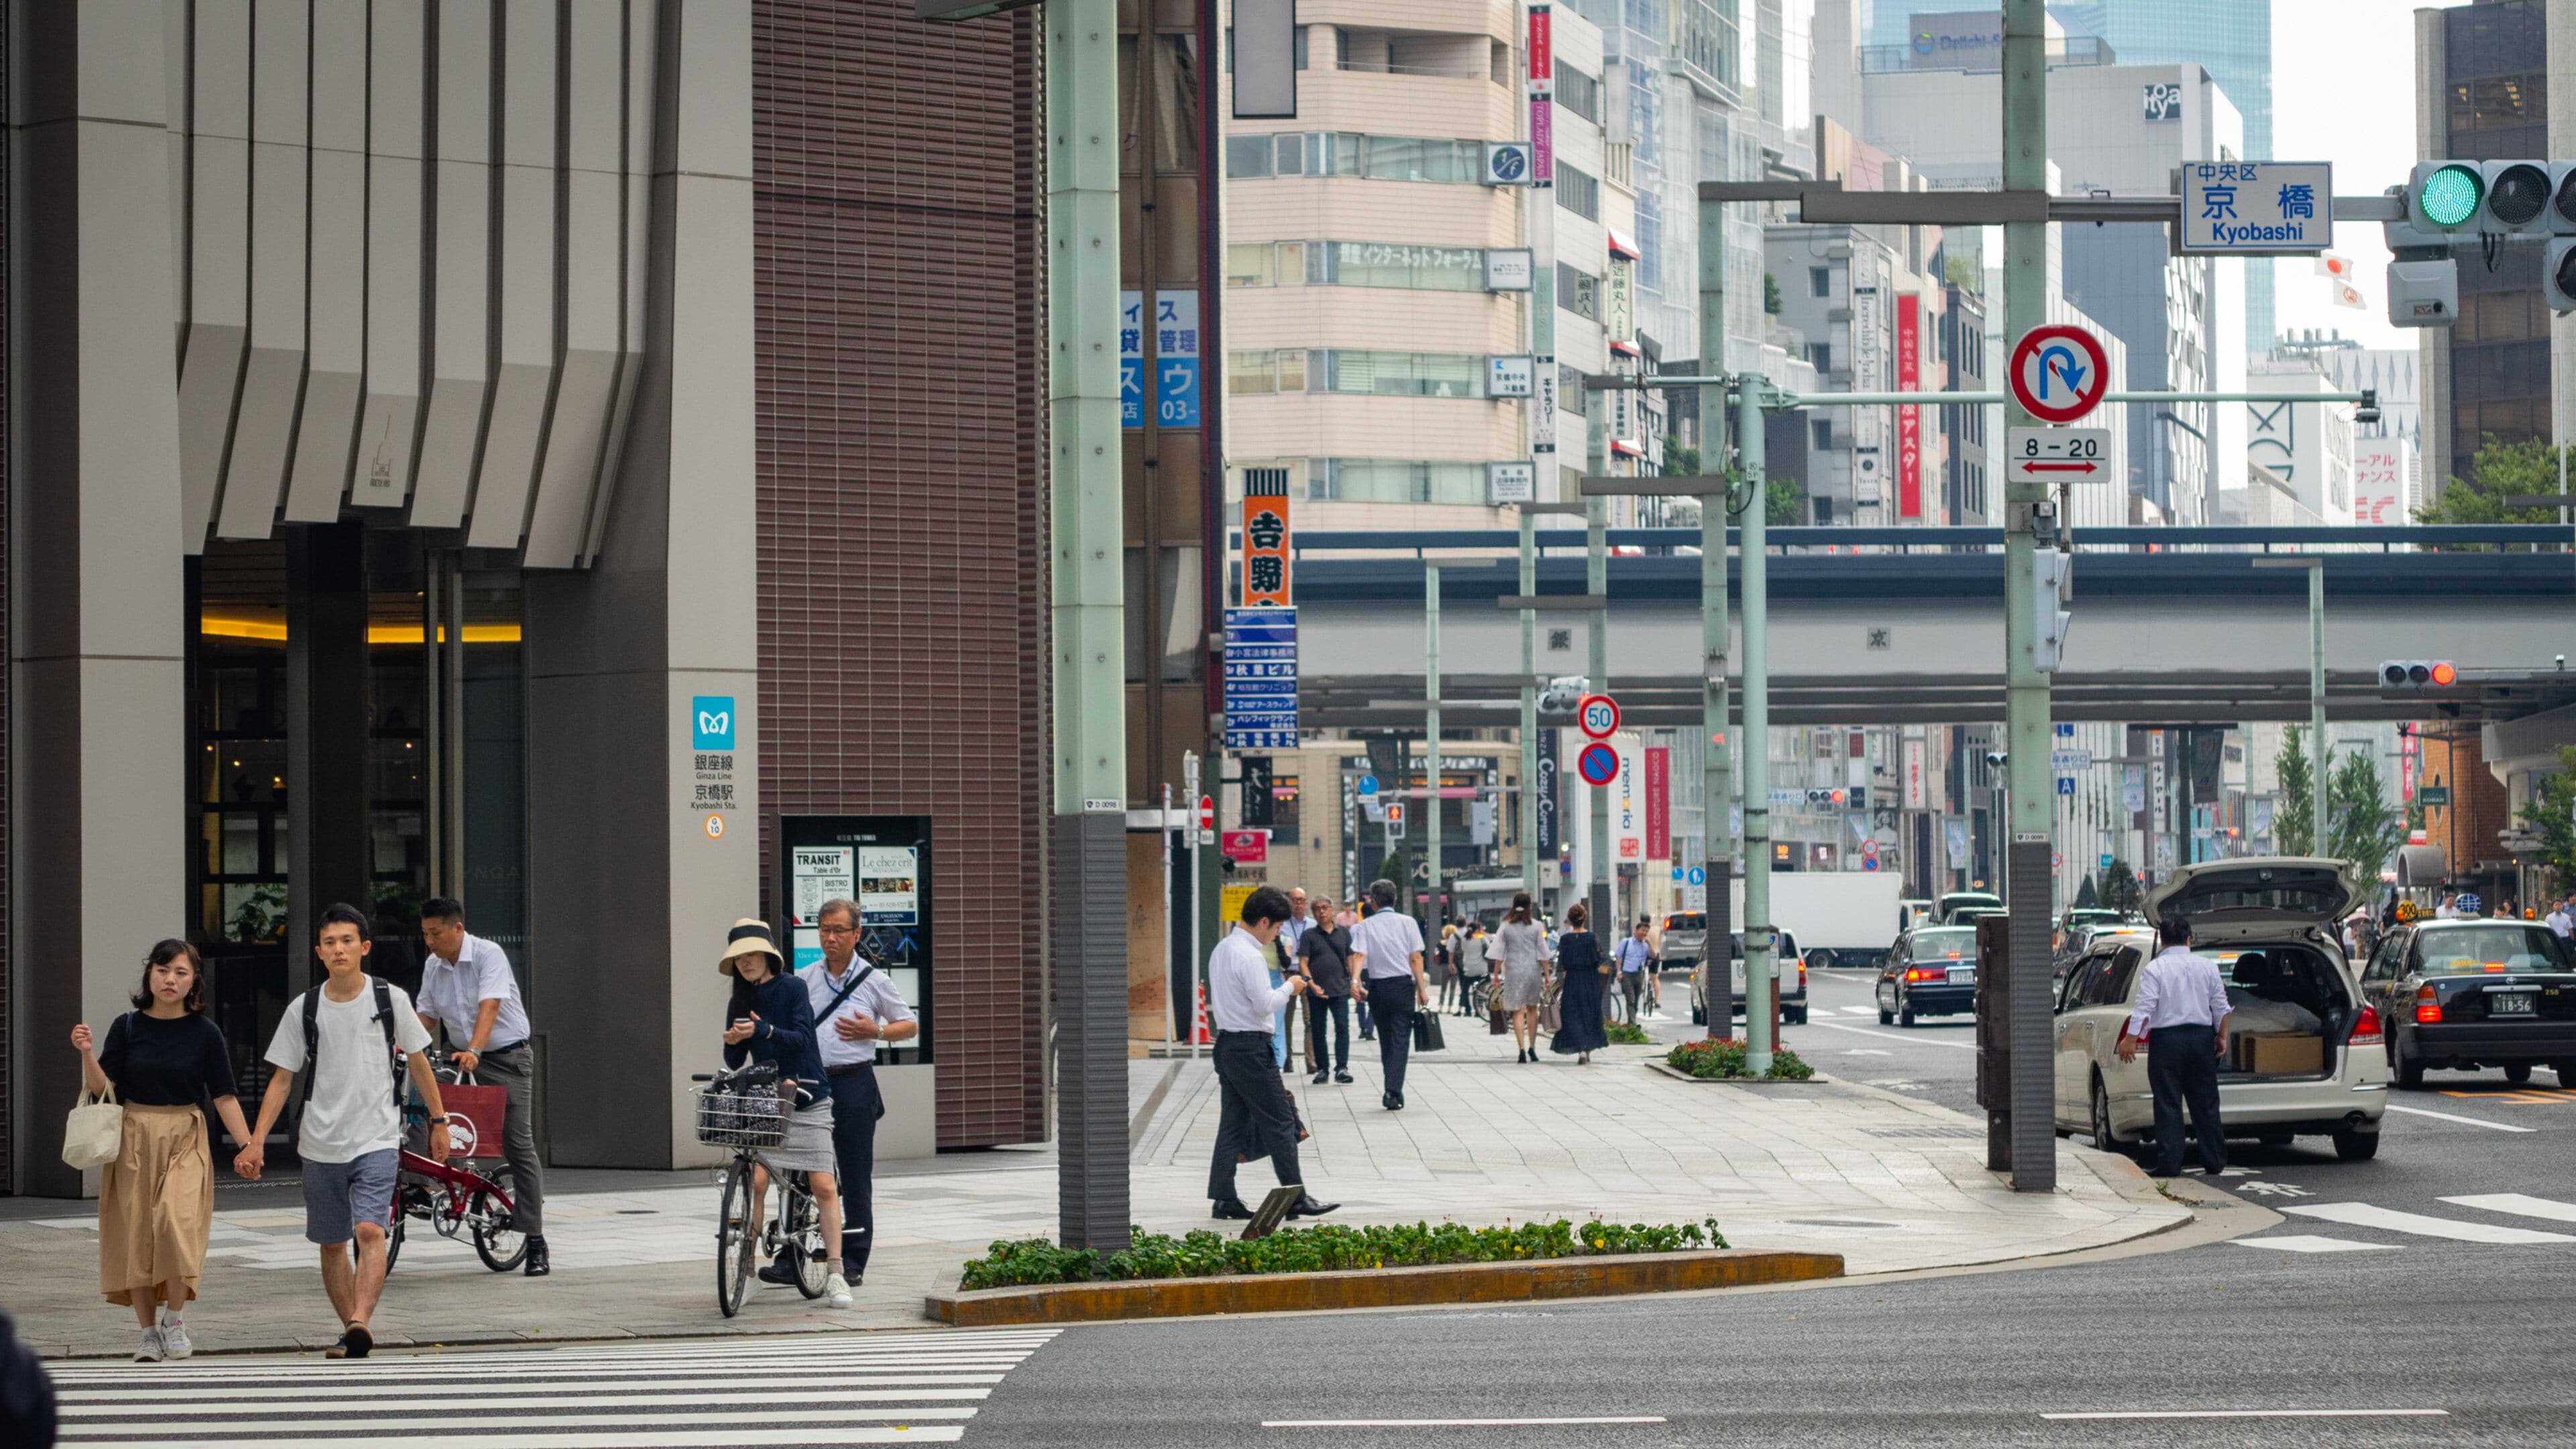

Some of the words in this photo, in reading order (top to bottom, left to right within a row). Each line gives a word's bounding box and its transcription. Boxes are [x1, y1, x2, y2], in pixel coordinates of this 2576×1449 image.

[2143, 83, 2182, 120] itoya
[2198, 164, 2257, 182] 中央区
[2201, 183, 2314, 220] 京橋
[2212, 222, 2304, 245] Kyobashi
[1161, 400, 1196, 419] 03-
[2355, 453, 2396, 468] ーアル
[1236, 663, 1295, 676] 秋葉ビル
[1588, 708, 1611, 727] 50
[694, 754, 734, 771] 銀座線
[2053, 755, 2088, 763] 座通り口
[696, 772, 716, 780] Ginza
[716, 772, 732, 780] Line
[694, 784, 734, 800] 京橋駅
[1622, 757, 1633, 829] memoria
[2061, 780, 2072, 793] A
[690, 801, 723, 810] Kyobashi
[724, 801, 737, 810] Sta.
[712, 818, 717, 826] G
[1538, 798, 1554, 847] Corner
[710, 826, 720, 834] 10
[796, 855, 841, 865] TRANSIT
[862, 855, 874, 868] Le
[877, 855, 896, 868] chez
[824, 879, 848, 888] BISTRO
[2402, 904, 2416, 915] 300
[2502, 1000, 2531, 1012] 18-56
